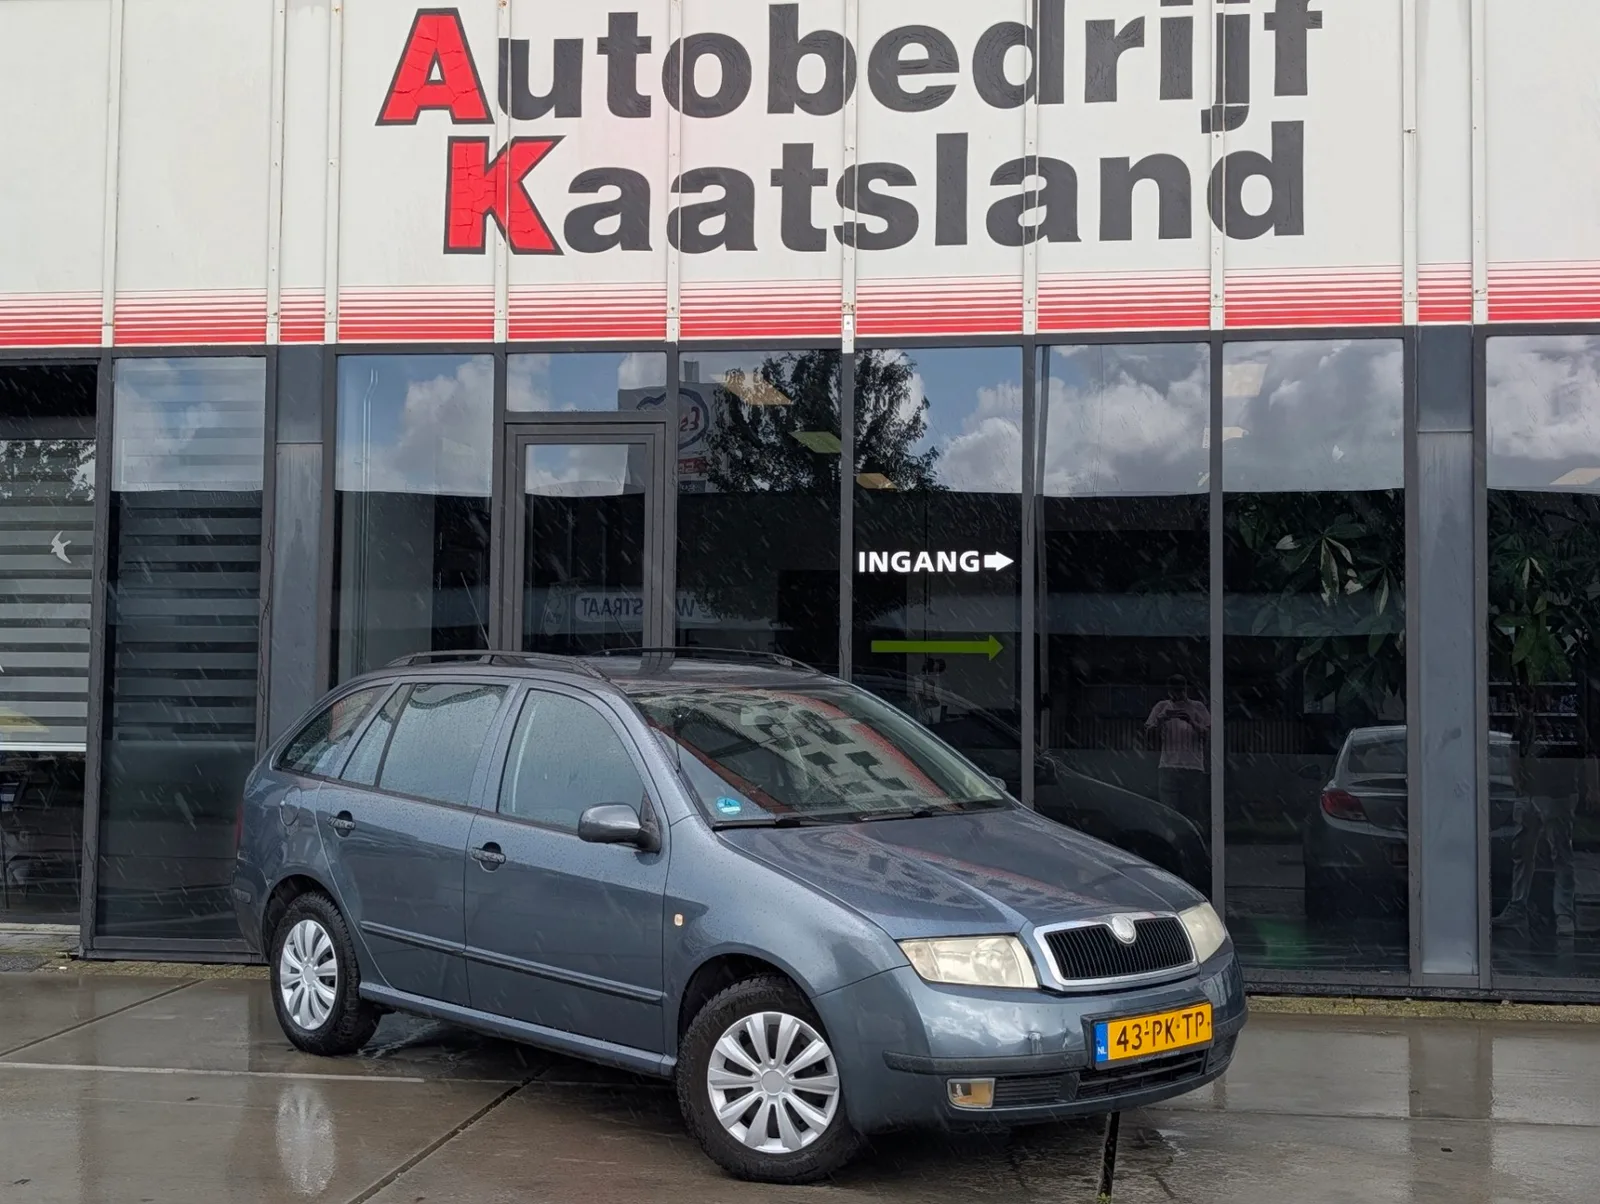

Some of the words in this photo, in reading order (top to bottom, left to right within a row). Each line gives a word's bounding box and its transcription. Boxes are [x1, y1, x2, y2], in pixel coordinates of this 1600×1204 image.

[375, 0, 1322, 133] Autobedrijf
[443, 120, 1305, 255] Kaatsland
[859, 551, 979, 572] INGANG
[1097, 1046, 1107, 1055] NL
